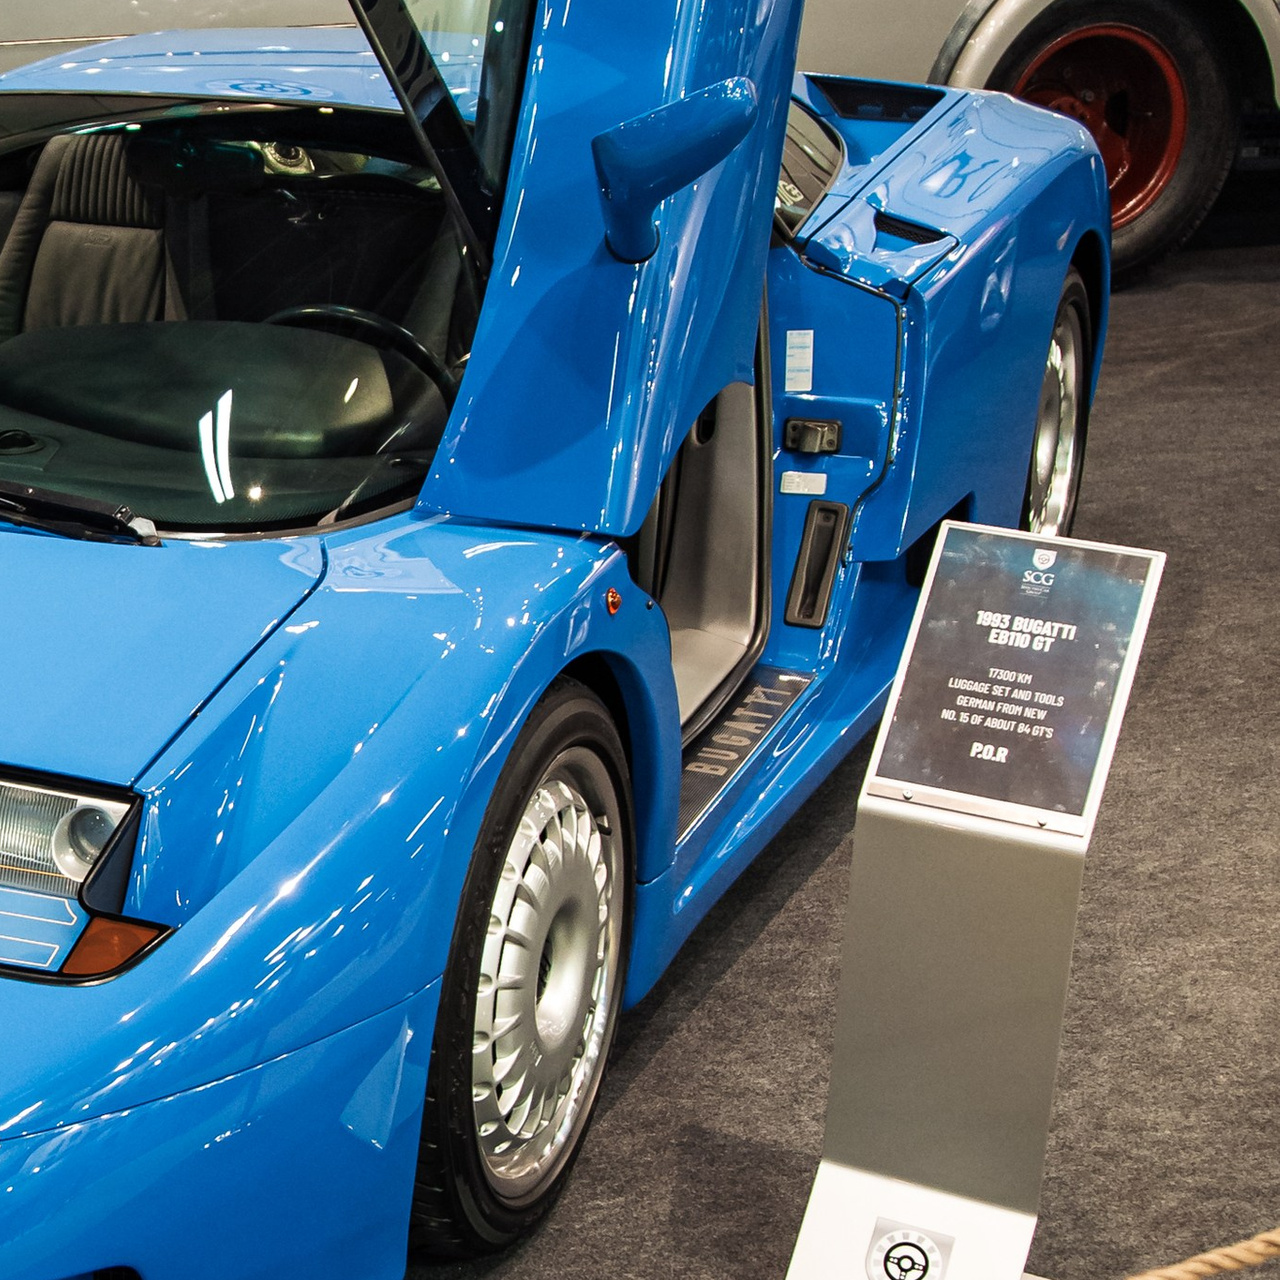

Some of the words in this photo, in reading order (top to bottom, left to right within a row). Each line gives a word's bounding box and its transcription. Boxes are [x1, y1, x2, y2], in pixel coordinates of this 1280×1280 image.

[1022, 570, 1055, 586] SCG
[976, 610, 1011, 629] 1993
[1011, 616, 1077, 640] BUGATTI
[988, 628, 1031, 649] EB110
[1032, 635, 1055, 652] GT
[988, 667, 1016, 682] 17300
[1017, 672, 1033, 685] KM
[948, 677, 991, 694] LUGGAGE
[991, 684, 1011, 697] SET
[1011, 688, 1032, 701] AND
[1034, 691, 1065, 707] TOOLS
[956, 695, 996, 712] GERMAN
[996, 702, 1023, 717] FROM
[1023, 707, 1048, 721] NEW
[685, 685, 792, 776] BUGATTI
[940, 709, 957, 721] NO.
[959, 712, 970, 724] 15
[970, 714, 984, 726] OF
[983, 717, 1017, 732] ABOUT
[1017, 722, 1031, 735] 84
[1031, 725, 1054, 739] GT'S
[969, 741, 1009, 763] P.O.R
